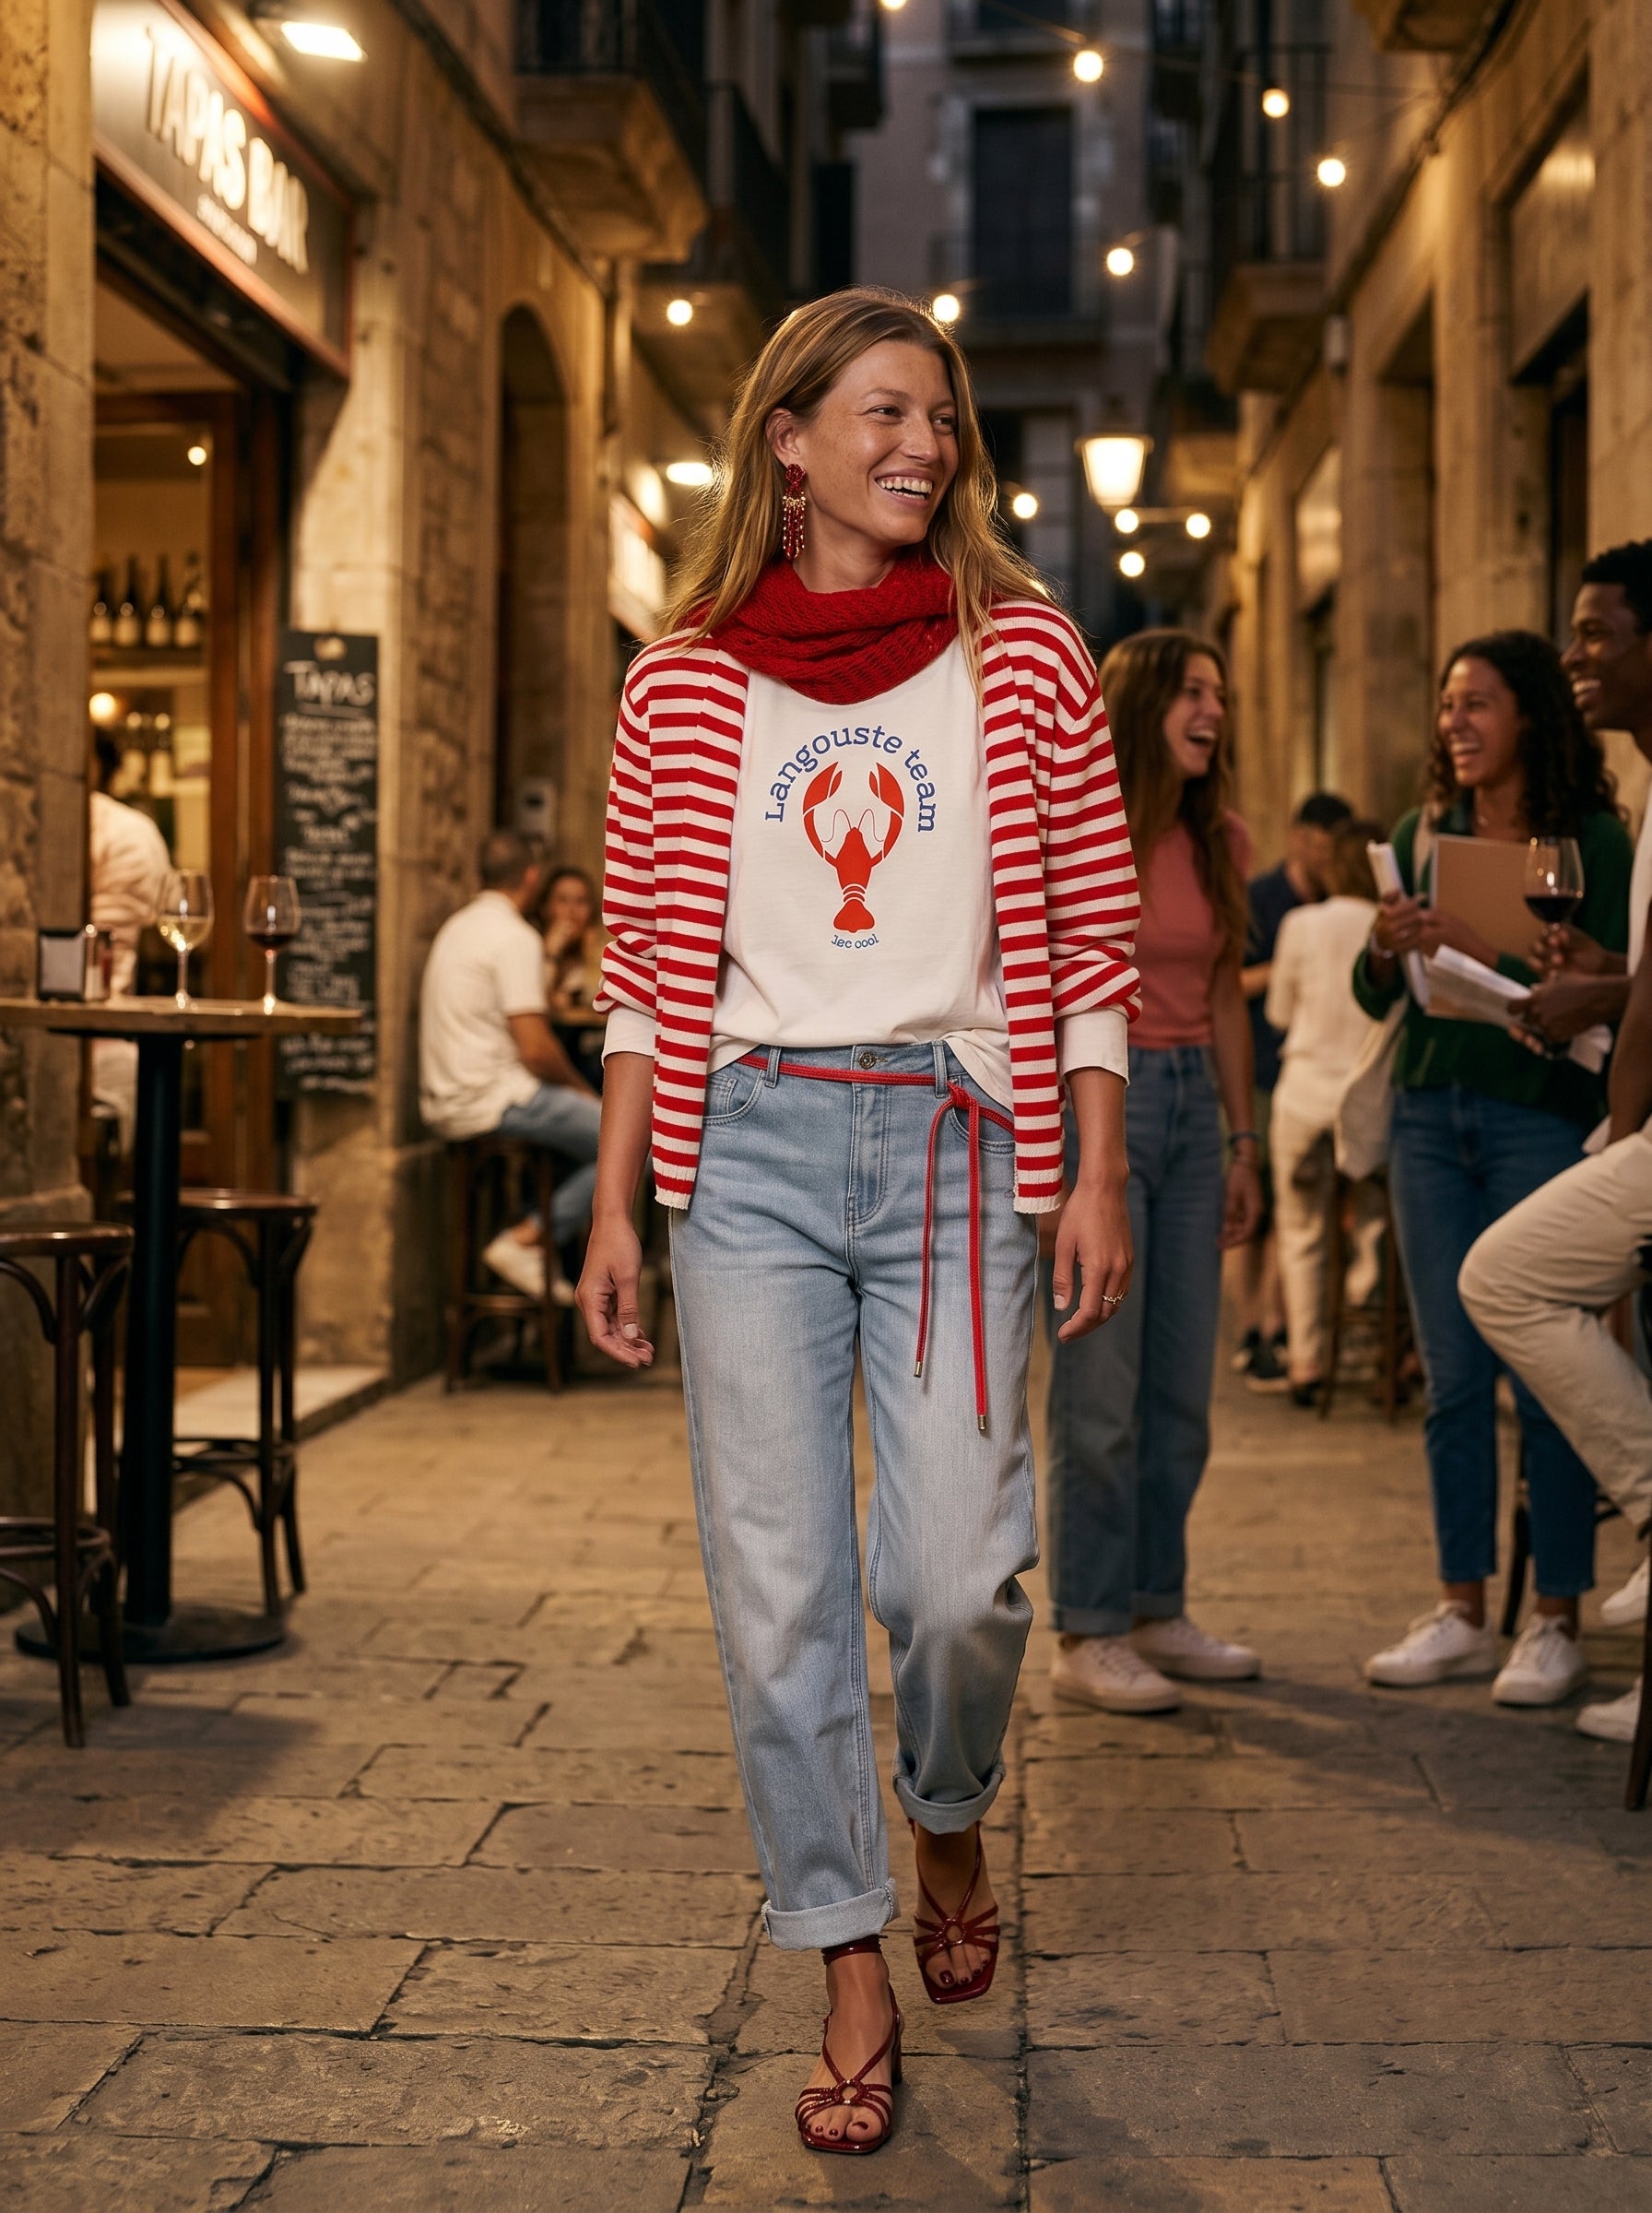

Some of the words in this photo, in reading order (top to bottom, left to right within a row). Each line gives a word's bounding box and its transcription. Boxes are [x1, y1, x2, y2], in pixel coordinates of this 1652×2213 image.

[146, 26, 247, 211] TAPAS
[247, 136, 310, 275] BAR
[764, 725, 903, 822] Langouste
[904, 749, 937, 833] team
